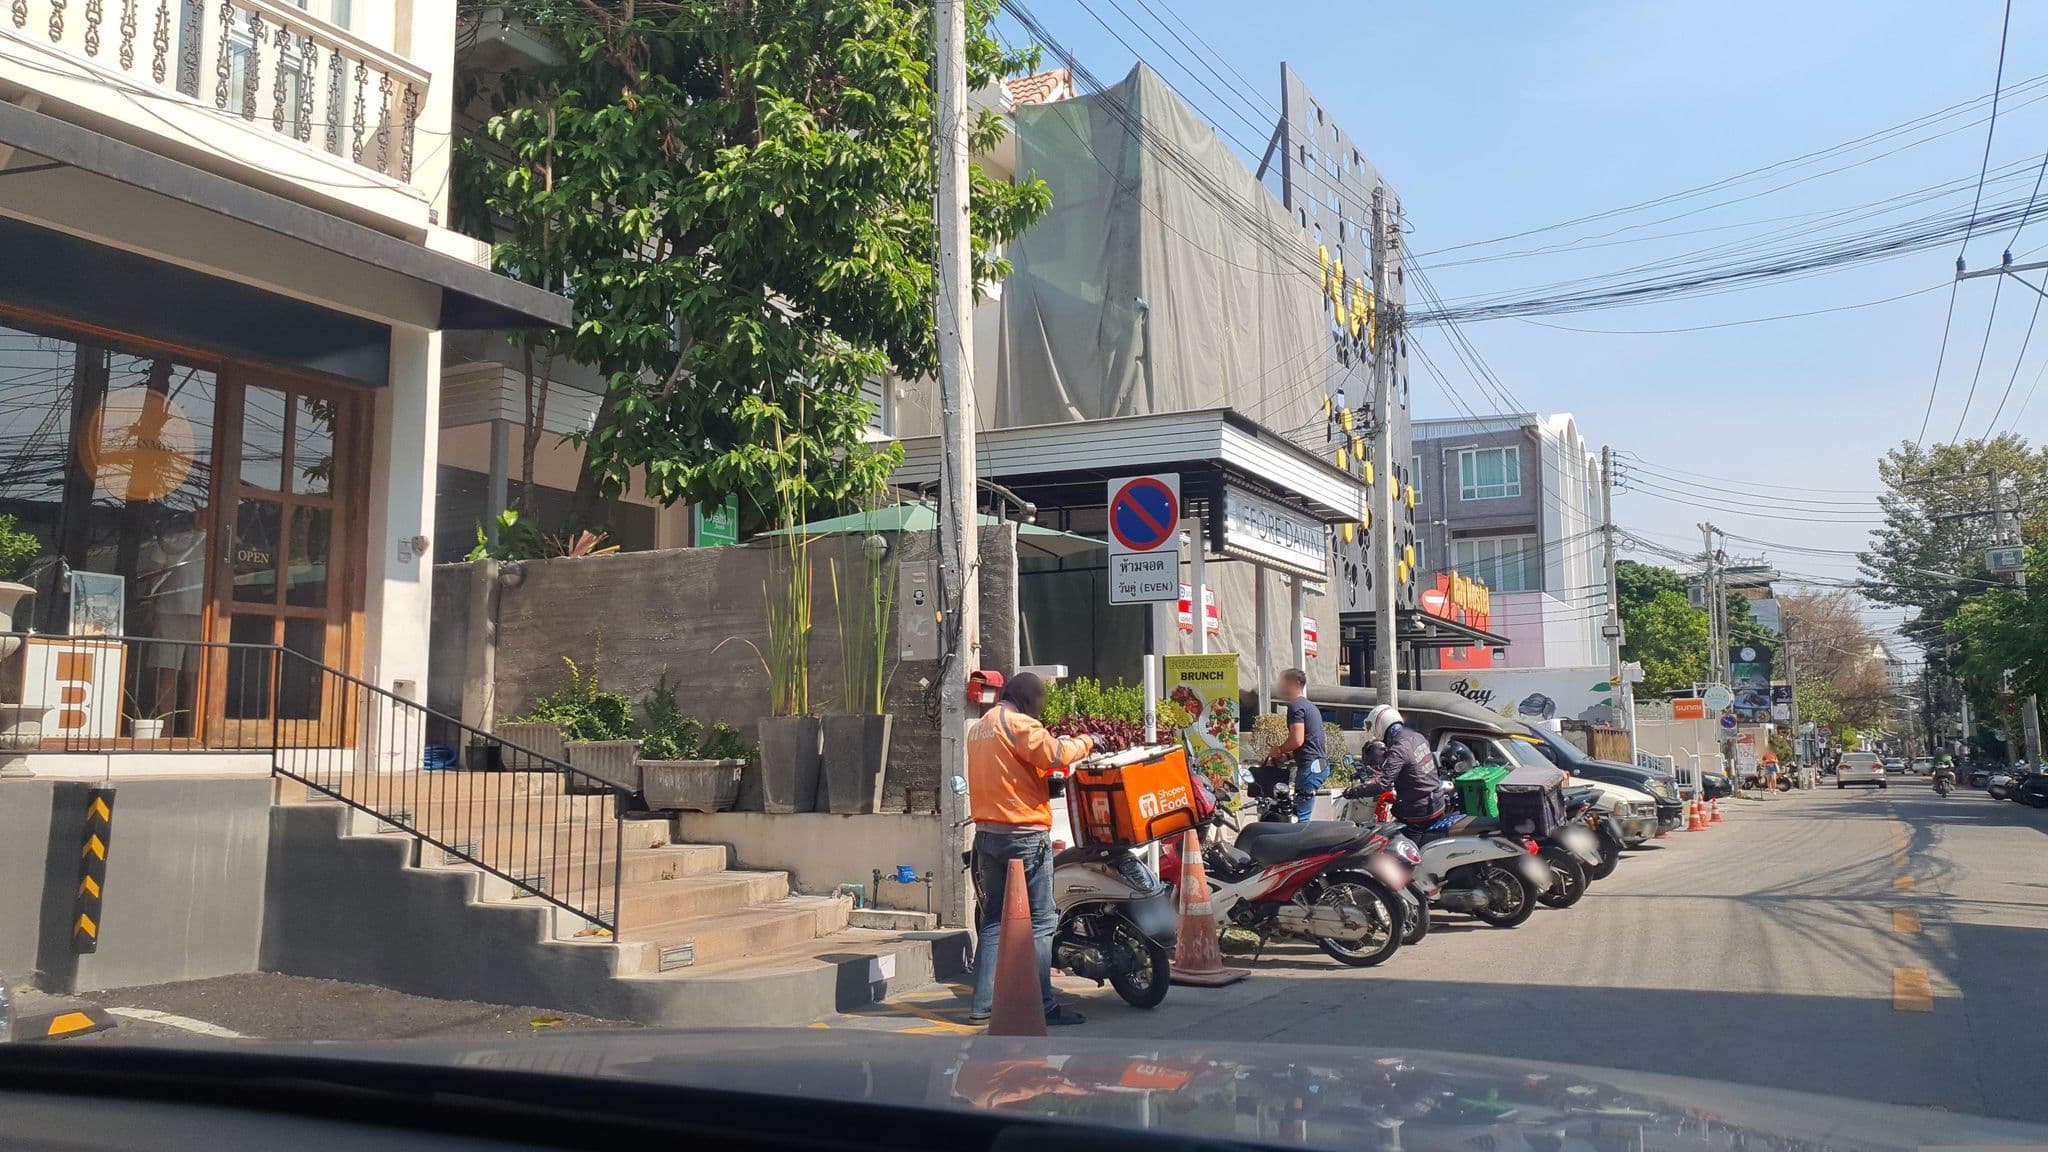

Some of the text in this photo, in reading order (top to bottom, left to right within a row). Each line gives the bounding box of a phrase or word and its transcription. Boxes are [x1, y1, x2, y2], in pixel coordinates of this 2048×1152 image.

[1234, 502, 1321, 556] EFORE DAWN
[238, 550, 270, 564] OPEN
[1120, 558, 1165, 573] ห้ามจอด
[1118, 581, 1174, 597] วันคู่ (EVEN)
[1180, 671, 1224, 681] BRUNCH
[1450, 679, 1497, 707] Ray
[1158, 786, 1185, 799] Shopee
[1160, 792, 1188, 813] Food
